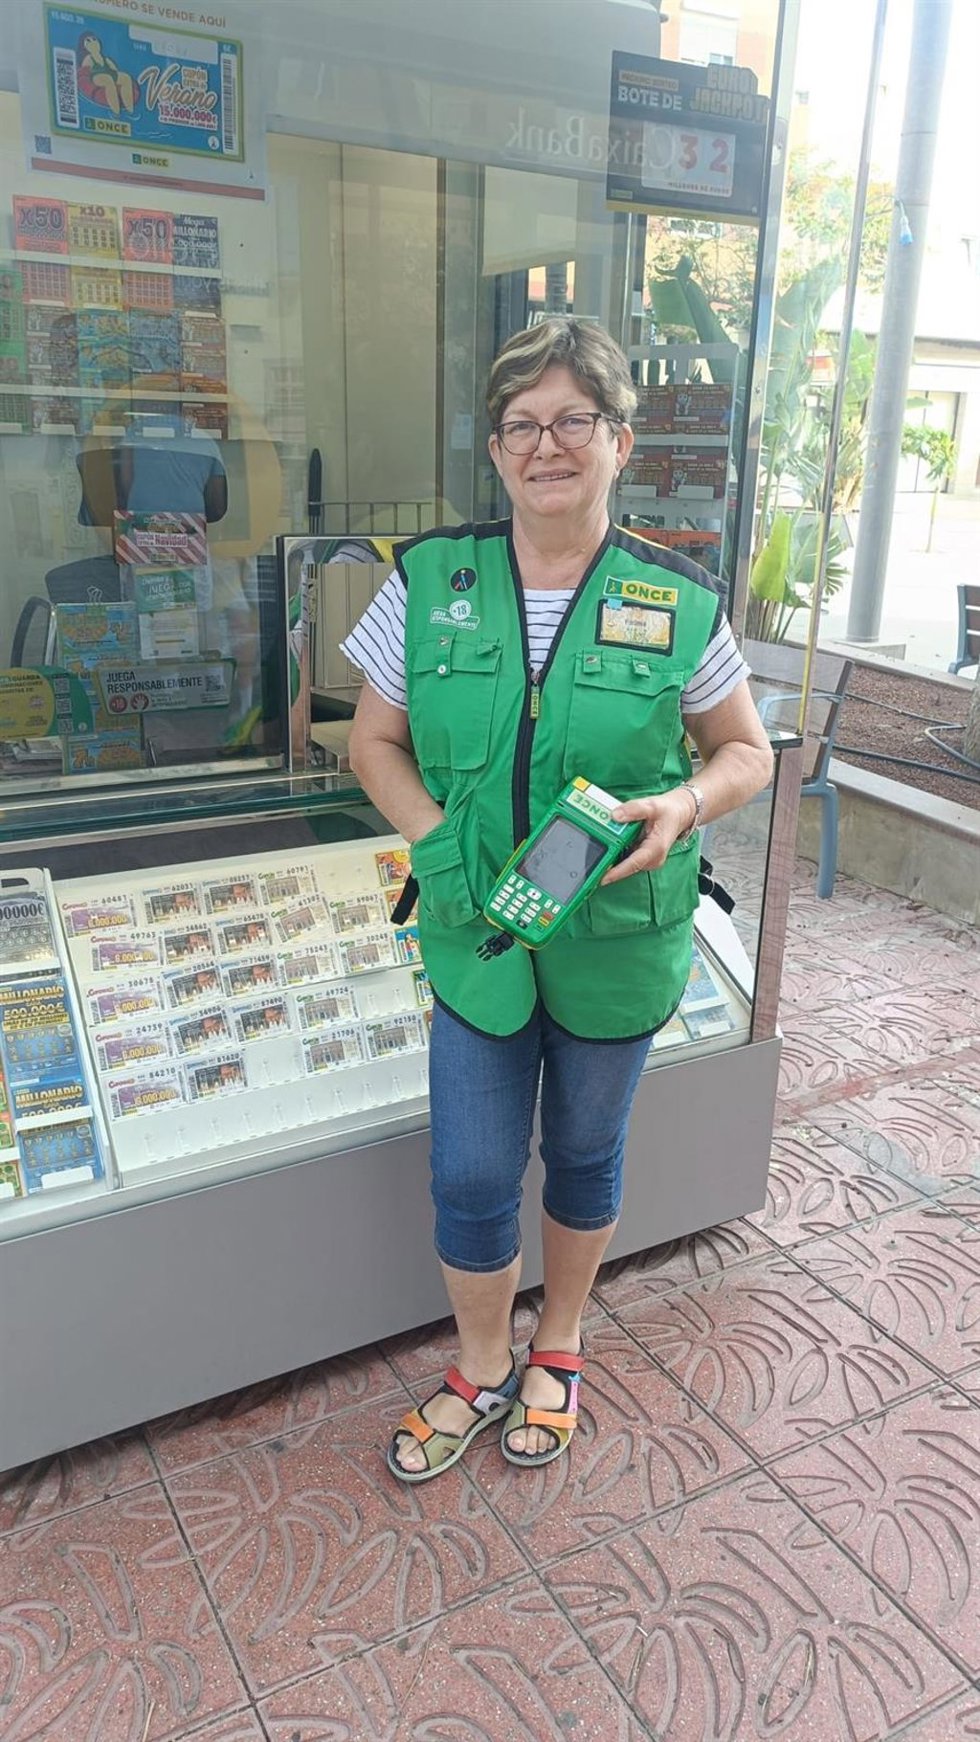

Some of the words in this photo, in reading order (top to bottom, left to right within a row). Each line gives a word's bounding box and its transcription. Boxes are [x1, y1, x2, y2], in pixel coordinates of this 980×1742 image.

[95, 0, 138, 10] MERO
[141, 3, 155, 15] SE
[158, 7, 195, 22] VENDE
[198, 14, 227, 28] AQUÍ
[138, 63, 218, 111] Verano
[618, 85, 660, 108] BOTE
[662, 92, 683, 111] DE
[690, 87, 766, 122] JACKPOT
[97, 121, 129, 134] ONCE
[143, 156, 168, 167] ONCE
[626, 583, 672, 602] ONCE
[106, 671, 136, 683] JUEGA
[107, 676, 203, 694] RESPONSABLEMENTE
[573, 795, 610, 821] ONCE
[4, 1001, 65, 1020] 500.000€
[16, 1084, 83, 1108] MILLONARIO
